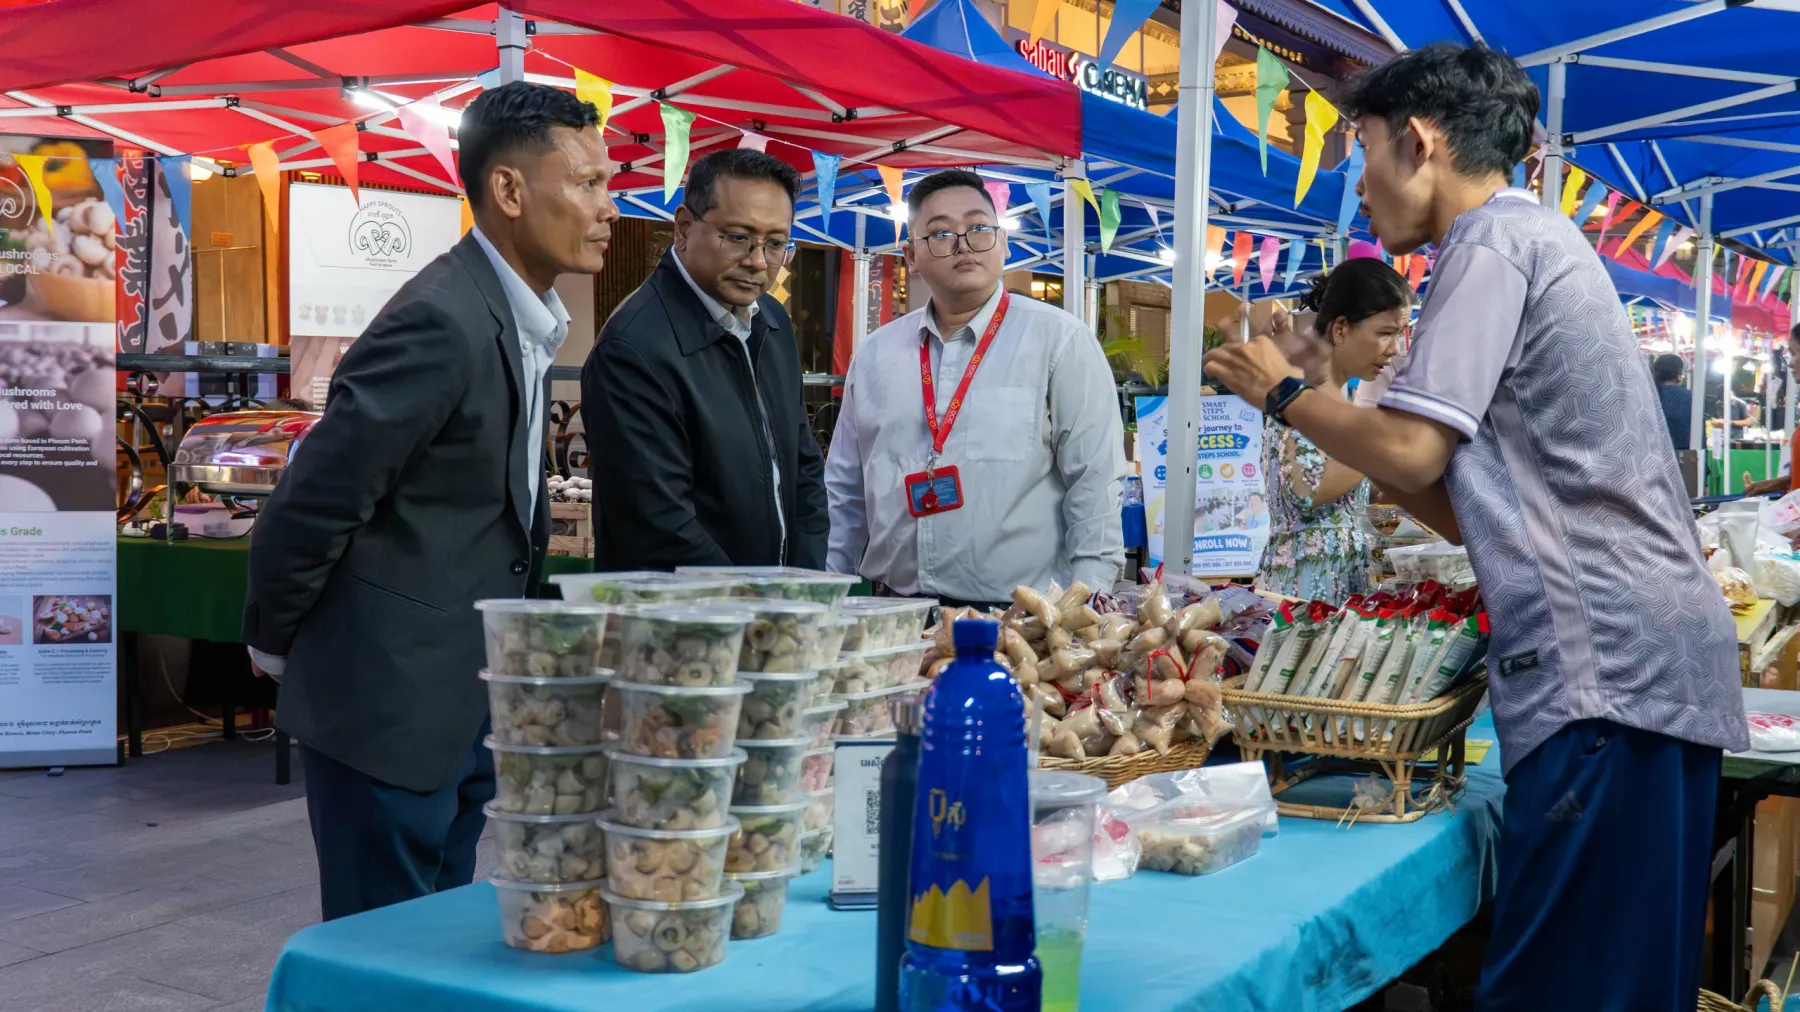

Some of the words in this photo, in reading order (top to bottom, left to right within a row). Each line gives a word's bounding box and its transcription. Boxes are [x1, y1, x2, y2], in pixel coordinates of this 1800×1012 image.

[0, 248, 58, 260] ushrooms
[0, 386, 57, 397] ushrooms
[31, 400, 54, 410] with
[57, 400, 83, 410] Love
[1203, 424, 1233, 434] journey
[1234, 423, 1243, 431] to
[1198, 434, 1235, 449] CESS
[10, 526, 43, 536] Grade
[1225, 538, 1248, 549] NOW
